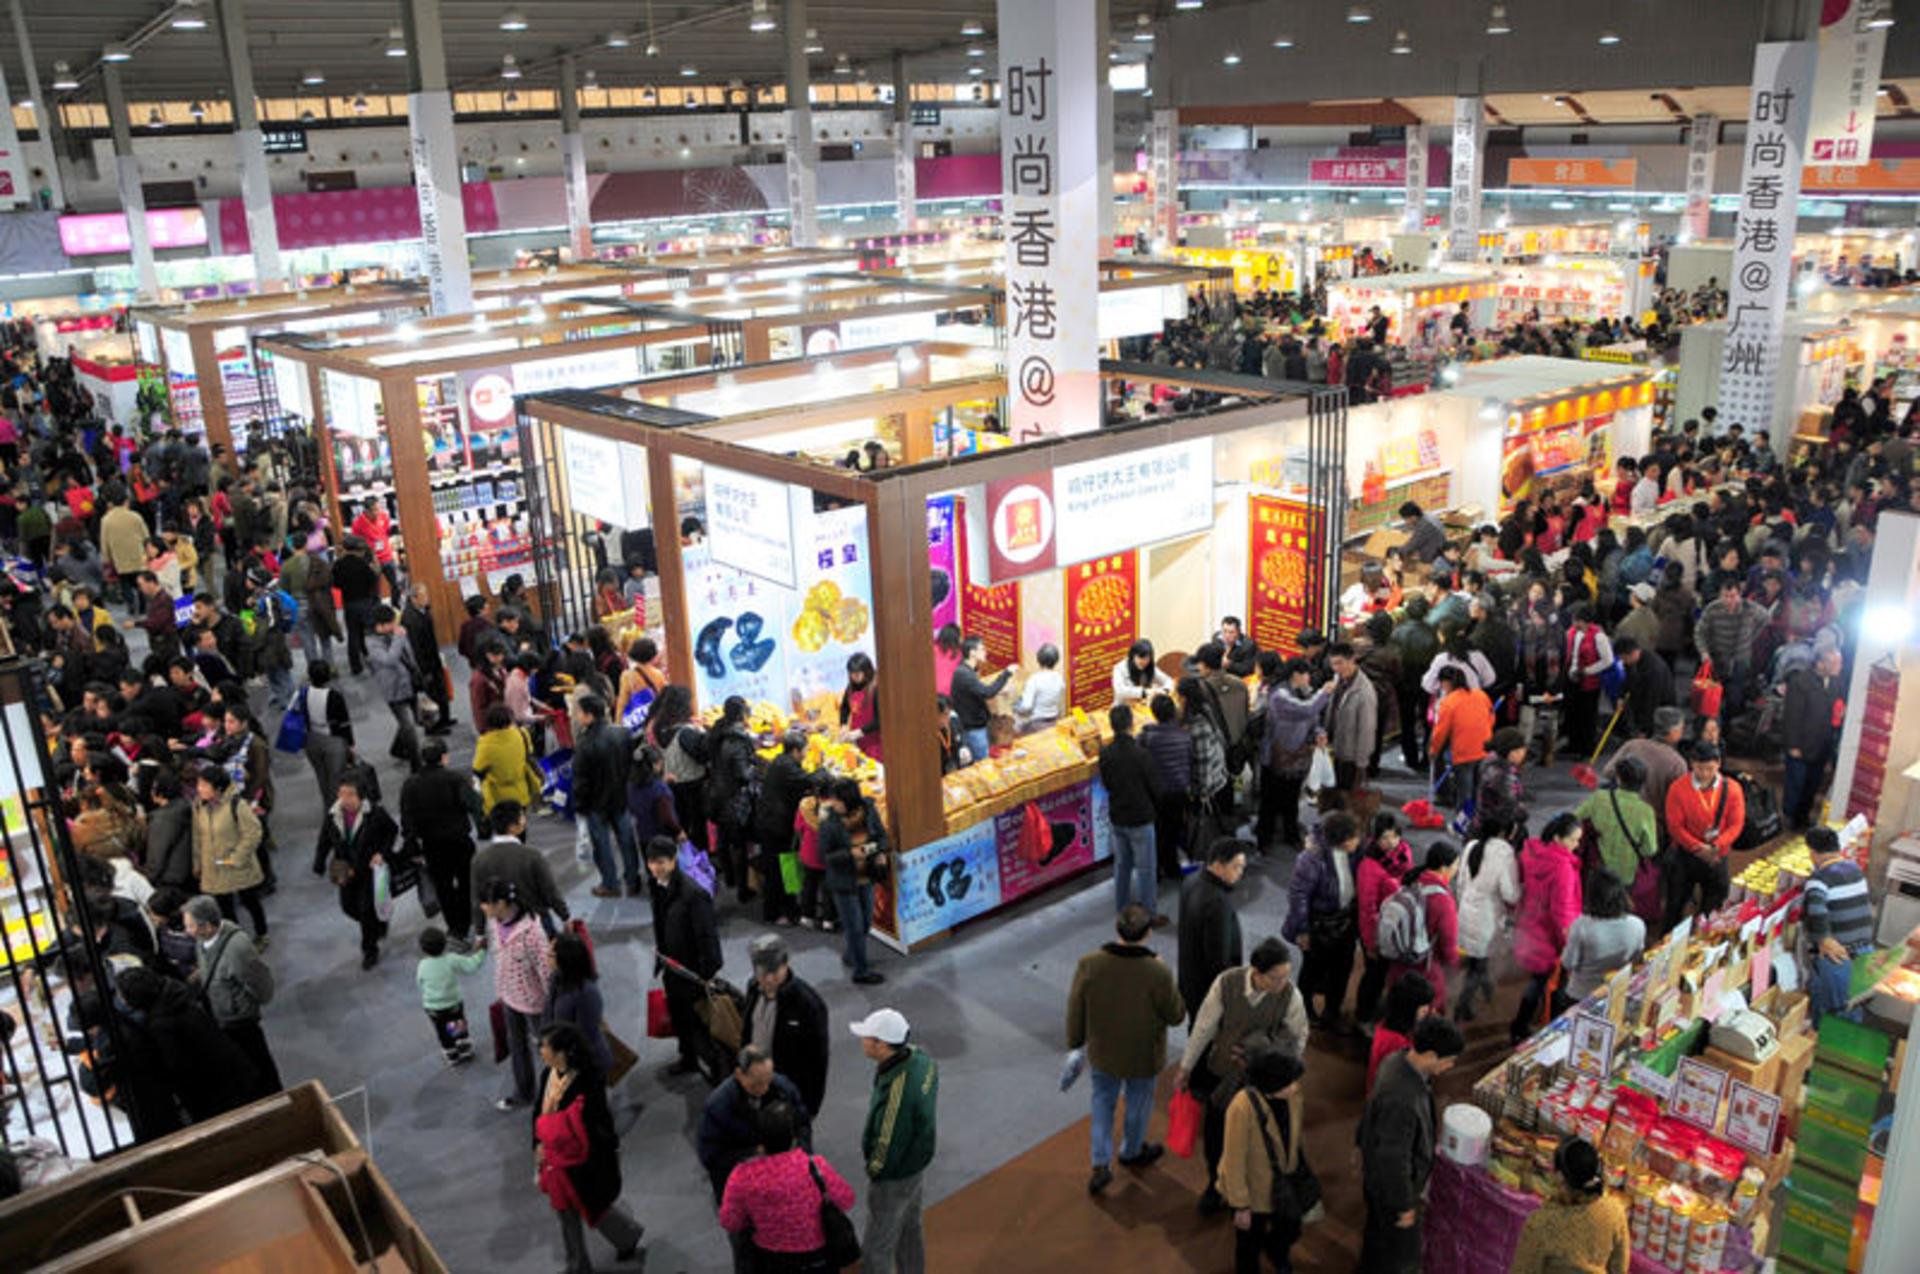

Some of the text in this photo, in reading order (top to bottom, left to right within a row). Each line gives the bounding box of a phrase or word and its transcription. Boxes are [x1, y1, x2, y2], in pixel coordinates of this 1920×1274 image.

[1554, 162, 1586, 180] 食品
[1726, 87, 1796, 377] 时尚香港@广州
